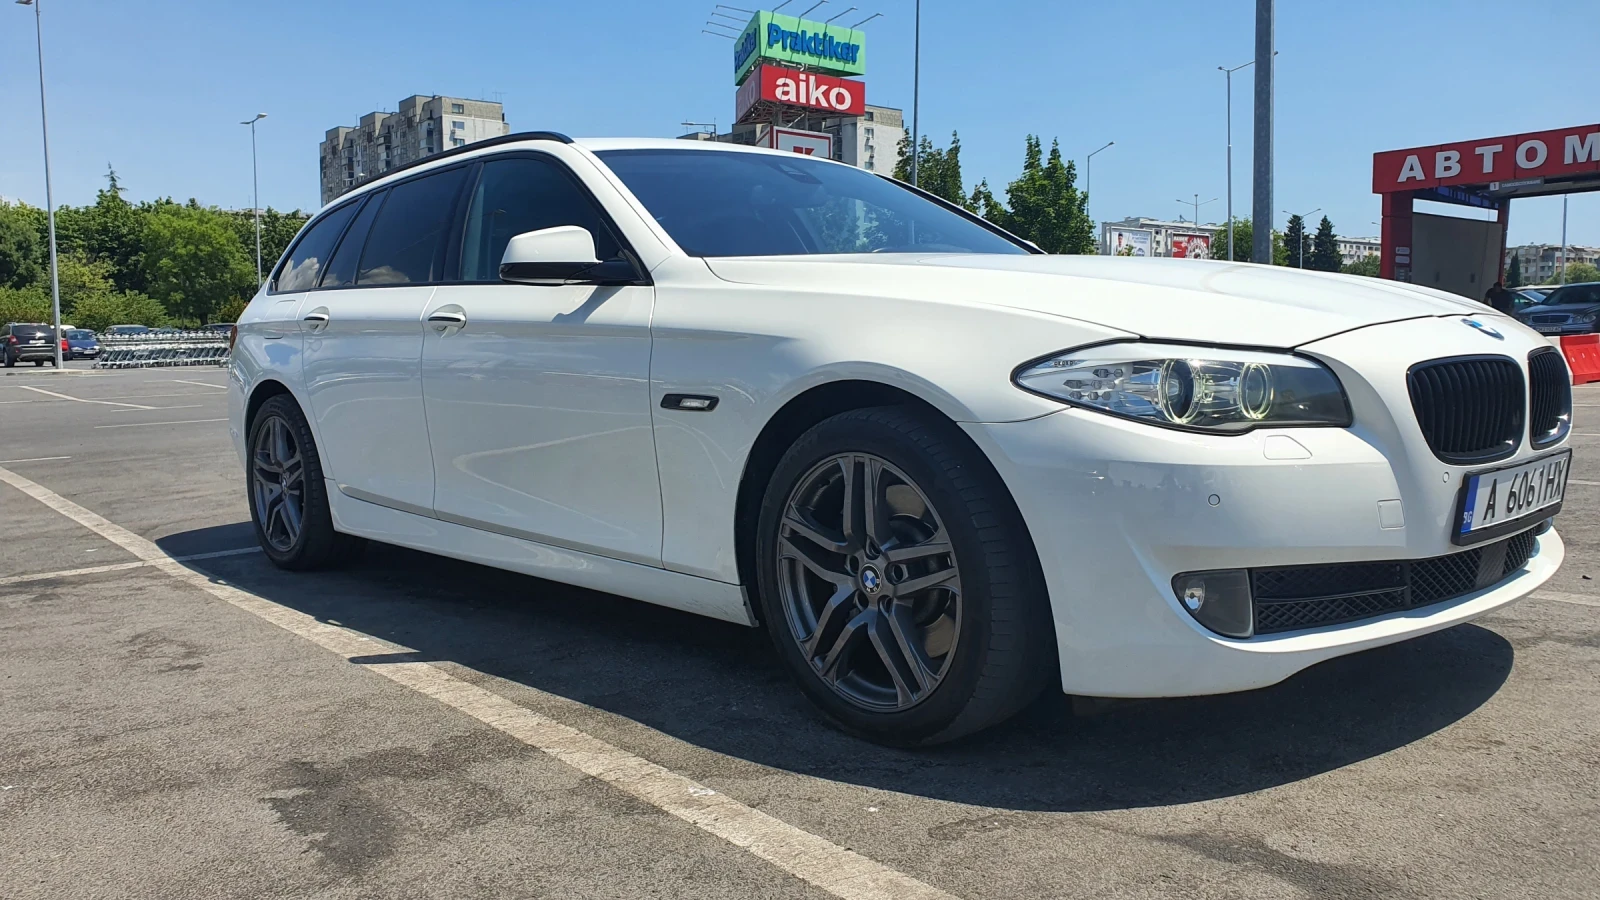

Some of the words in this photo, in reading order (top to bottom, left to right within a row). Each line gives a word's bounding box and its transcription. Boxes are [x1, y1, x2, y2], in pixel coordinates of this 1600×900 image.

[767, 23, 860, 65] Praktiker
[775, 74, 852, 110] aiko
[1483, 478, 1498, 521] A
